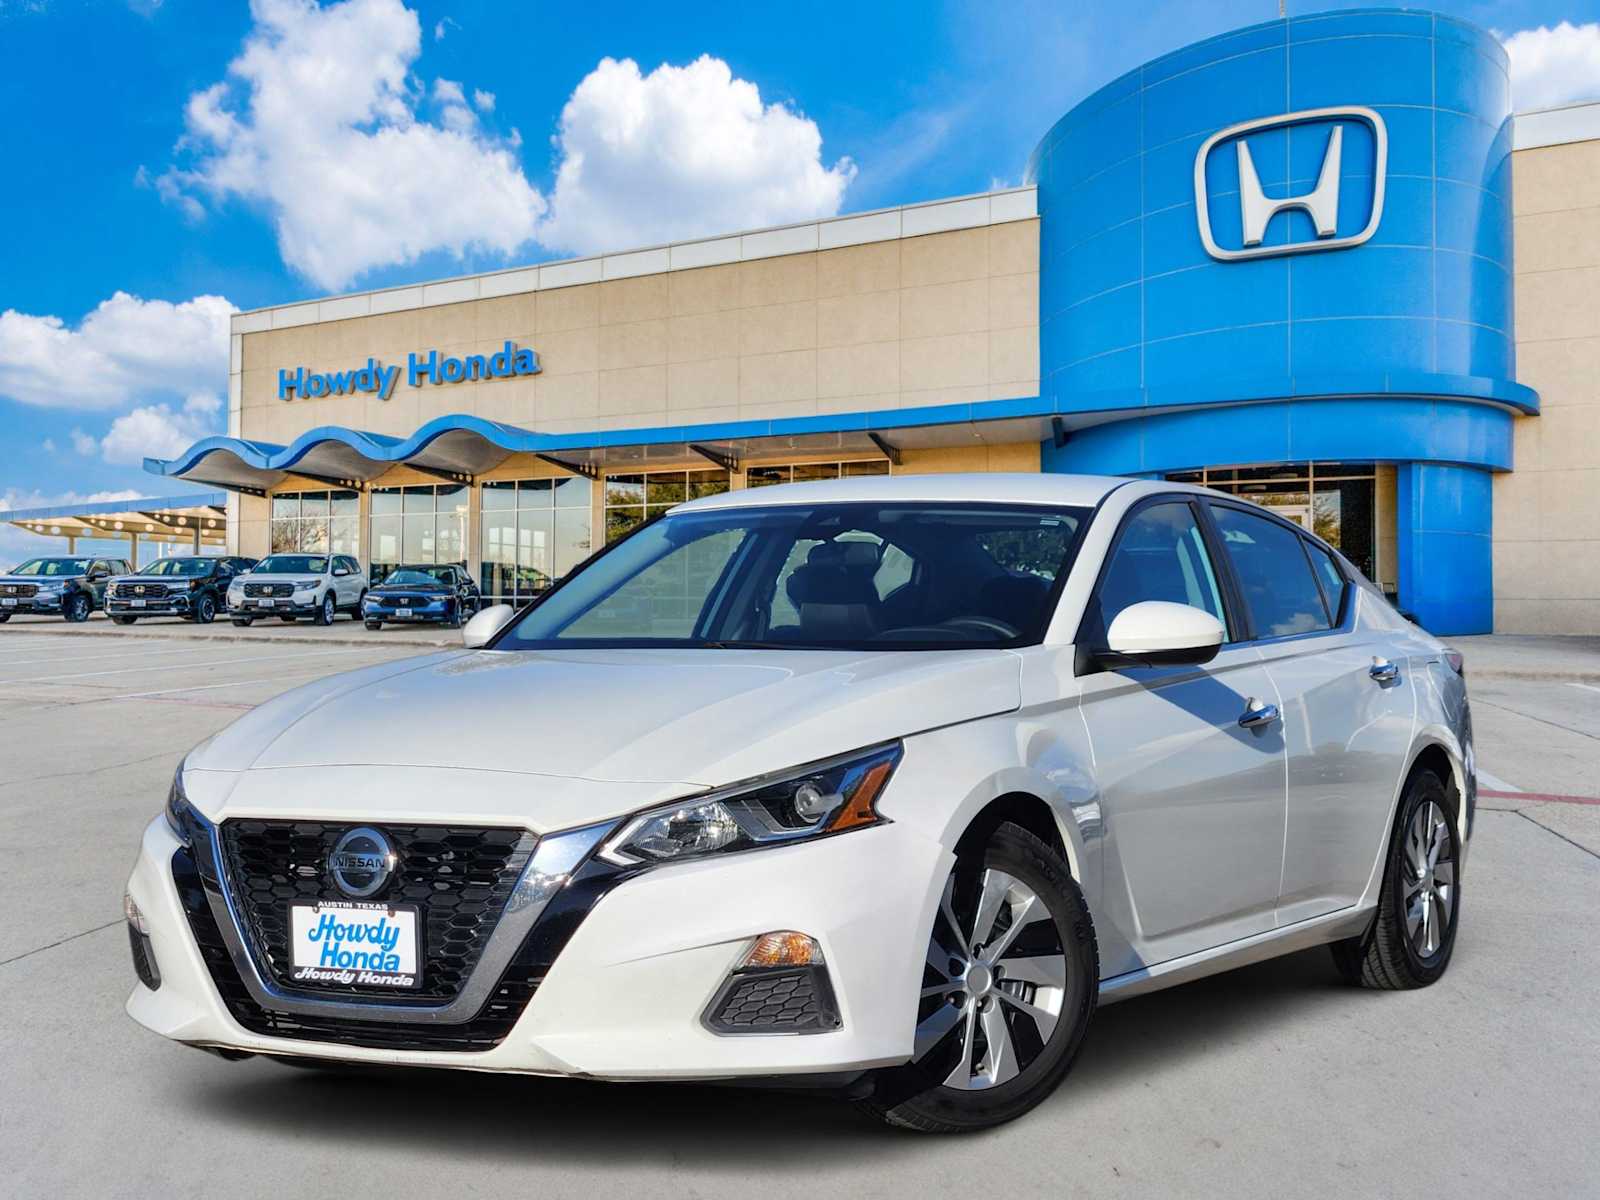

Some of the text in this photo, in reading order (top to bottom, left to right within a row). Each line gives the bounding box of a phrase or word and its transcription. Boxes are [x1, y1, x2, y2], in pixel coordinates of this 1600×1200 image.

[278, 341, 541, 401] Howdy Honda
[335, 856, 384, 868] NISSAN
[308, 914, 400, 952] Howdy
[320, 942, 400, 971] Honda
[294, 967, 414, 986] Howdy Honda
